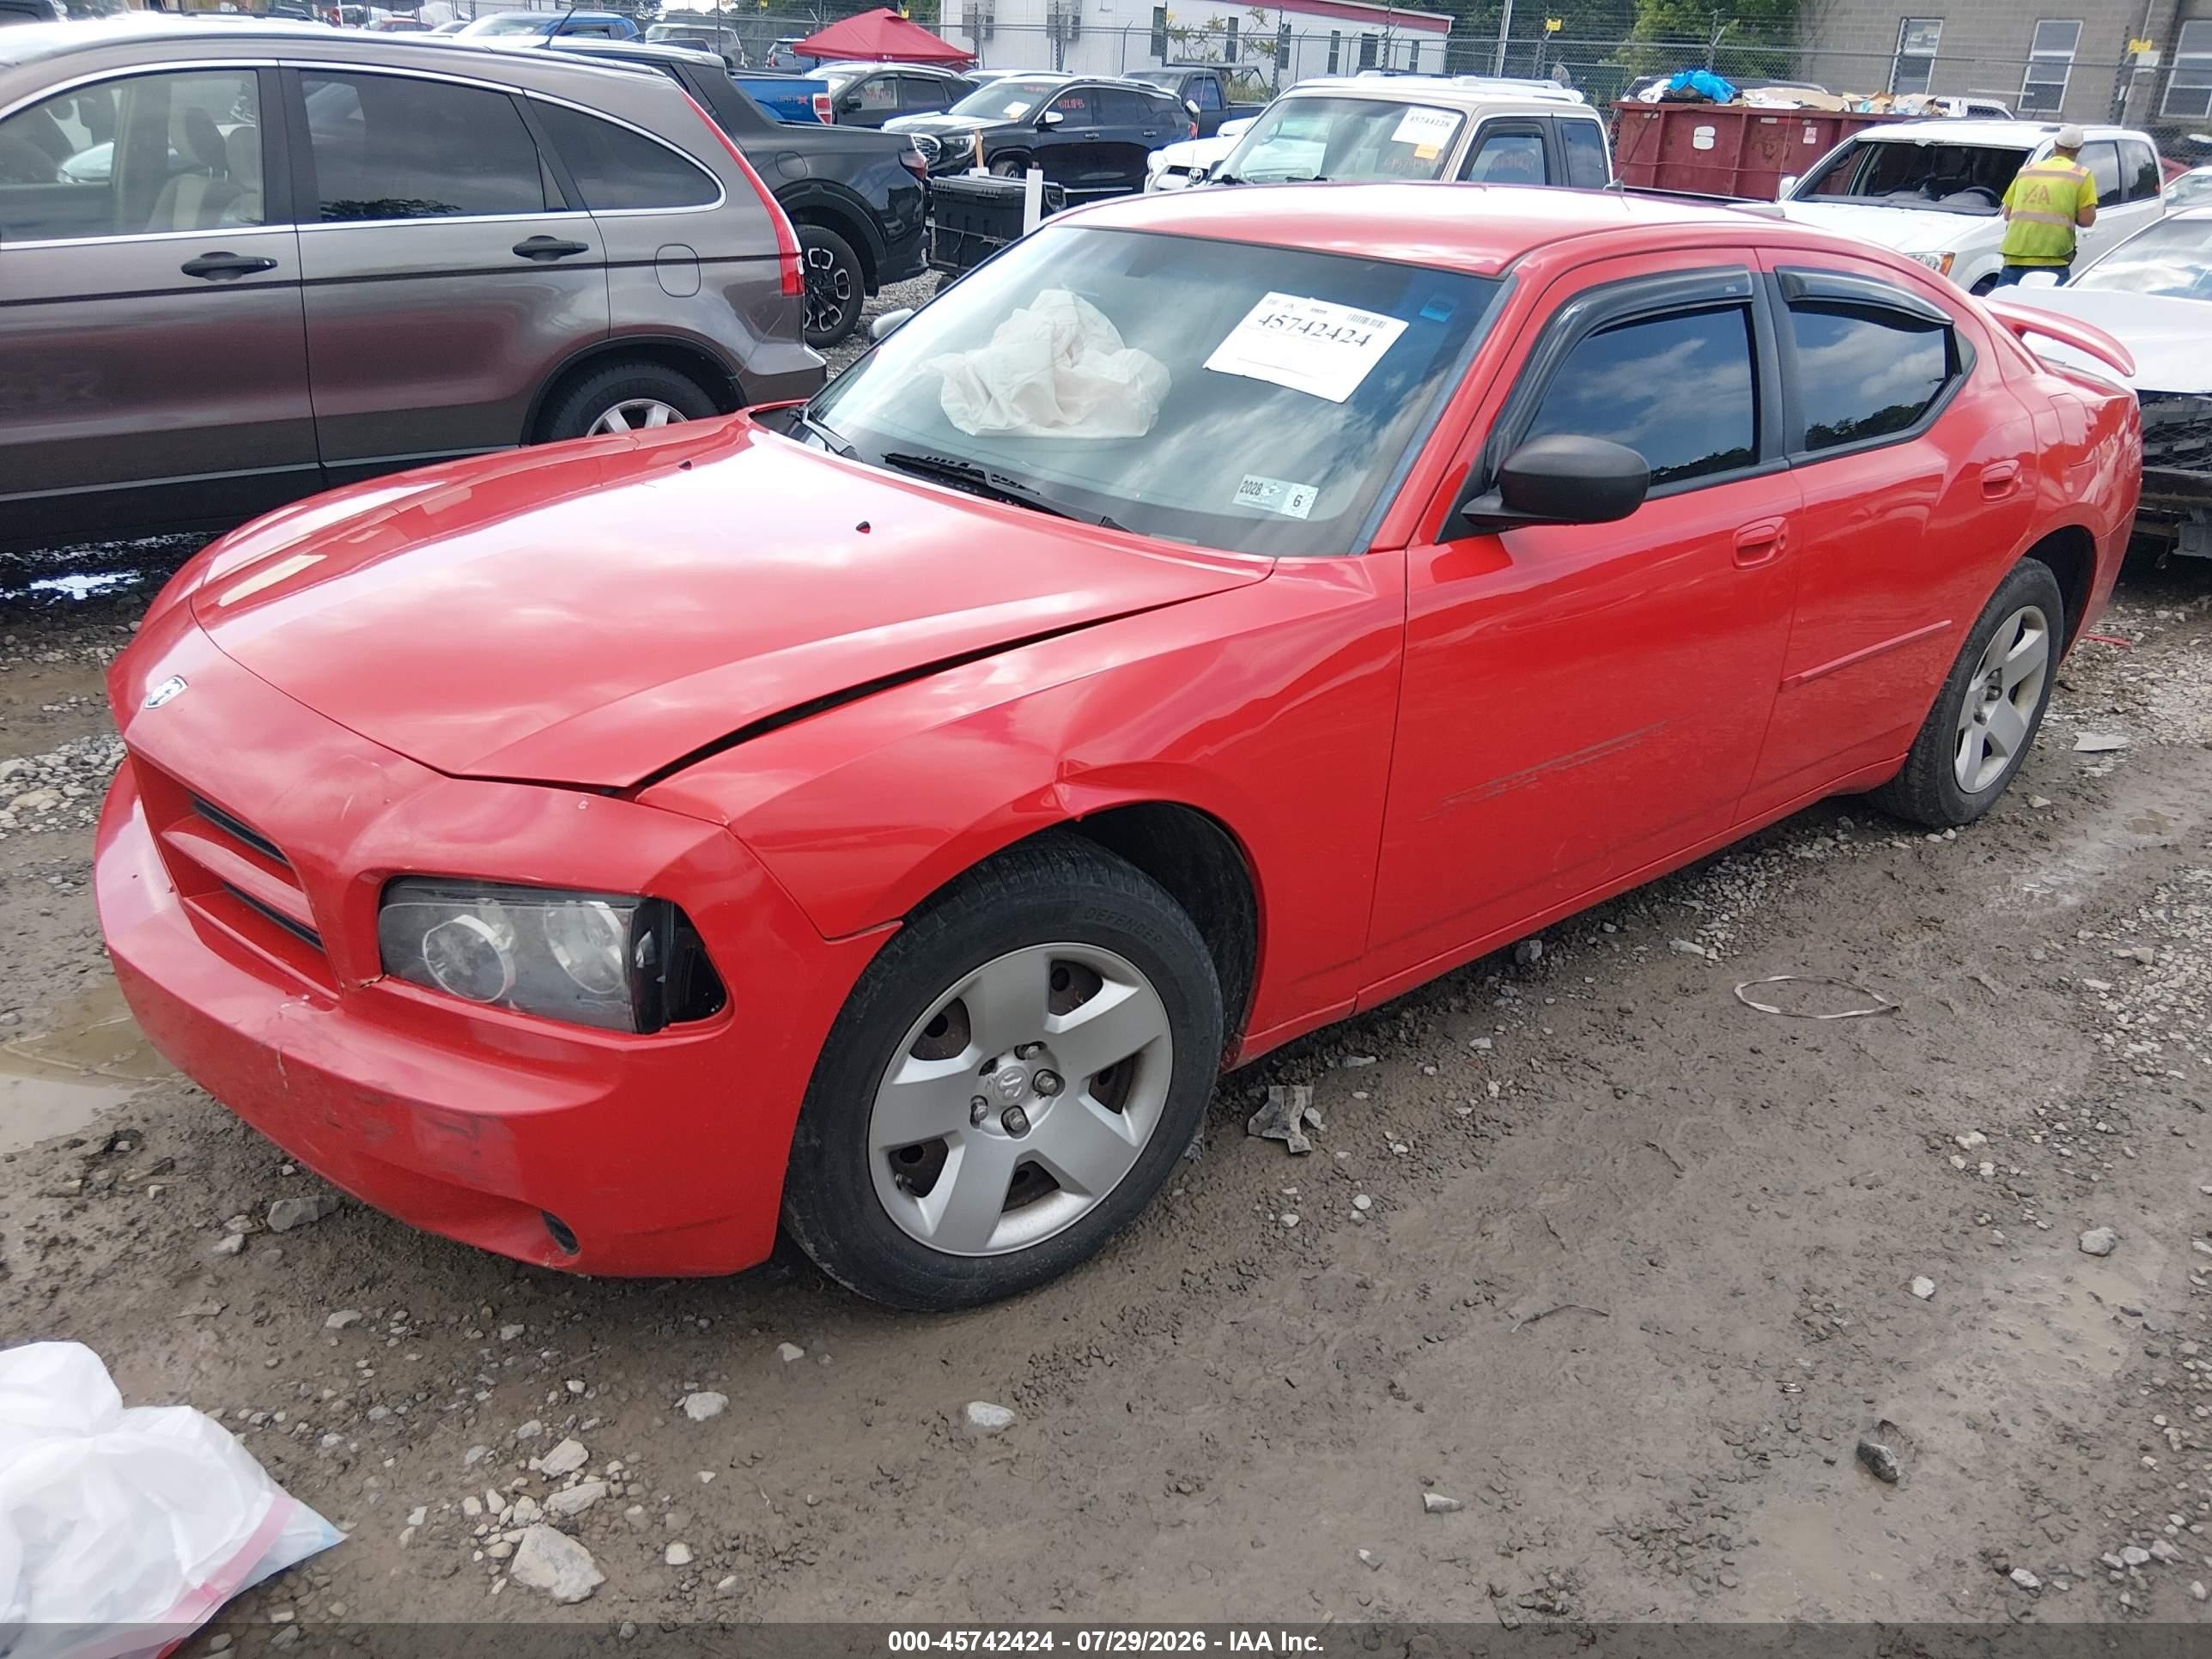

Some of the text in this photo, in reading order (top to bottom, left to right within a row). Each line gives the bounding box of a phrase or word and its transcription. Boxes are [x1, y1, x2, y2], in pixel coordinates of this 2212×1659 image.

[1257, 313, 1373, 348] 45742424
[1239, 479, 1264, 496] 2028
[1292, 494, 1304, 508] 6
[1084, 905, 1164, 944] DEFENDER
